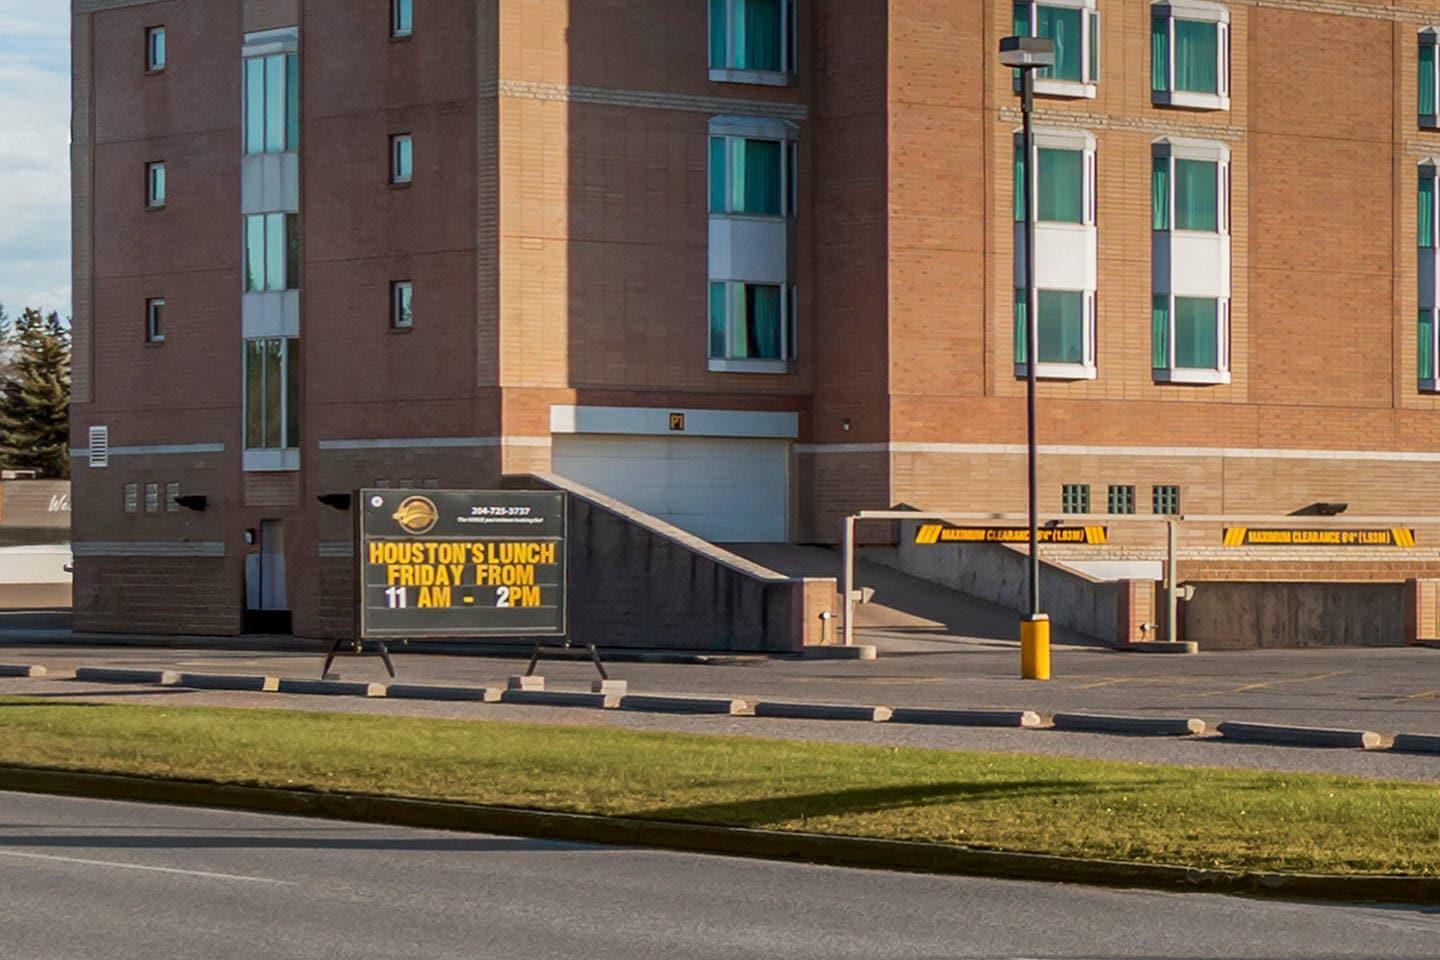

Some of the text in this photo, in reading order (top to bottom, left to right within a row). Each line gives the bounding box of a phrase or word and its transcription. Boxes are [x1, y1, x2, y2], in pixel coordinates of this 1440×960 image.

[987, 529, 1031, 541] CLEARANC
[1292, 531, 1340, 544] CLEARANCE
[369, 542, 555, 565] HOUSTON'S LUNCH
[387, 565, 535, 586] FRIDAY FROM
[385, 586, 407, 608] 11
[417, 586, 452, 608] AM
